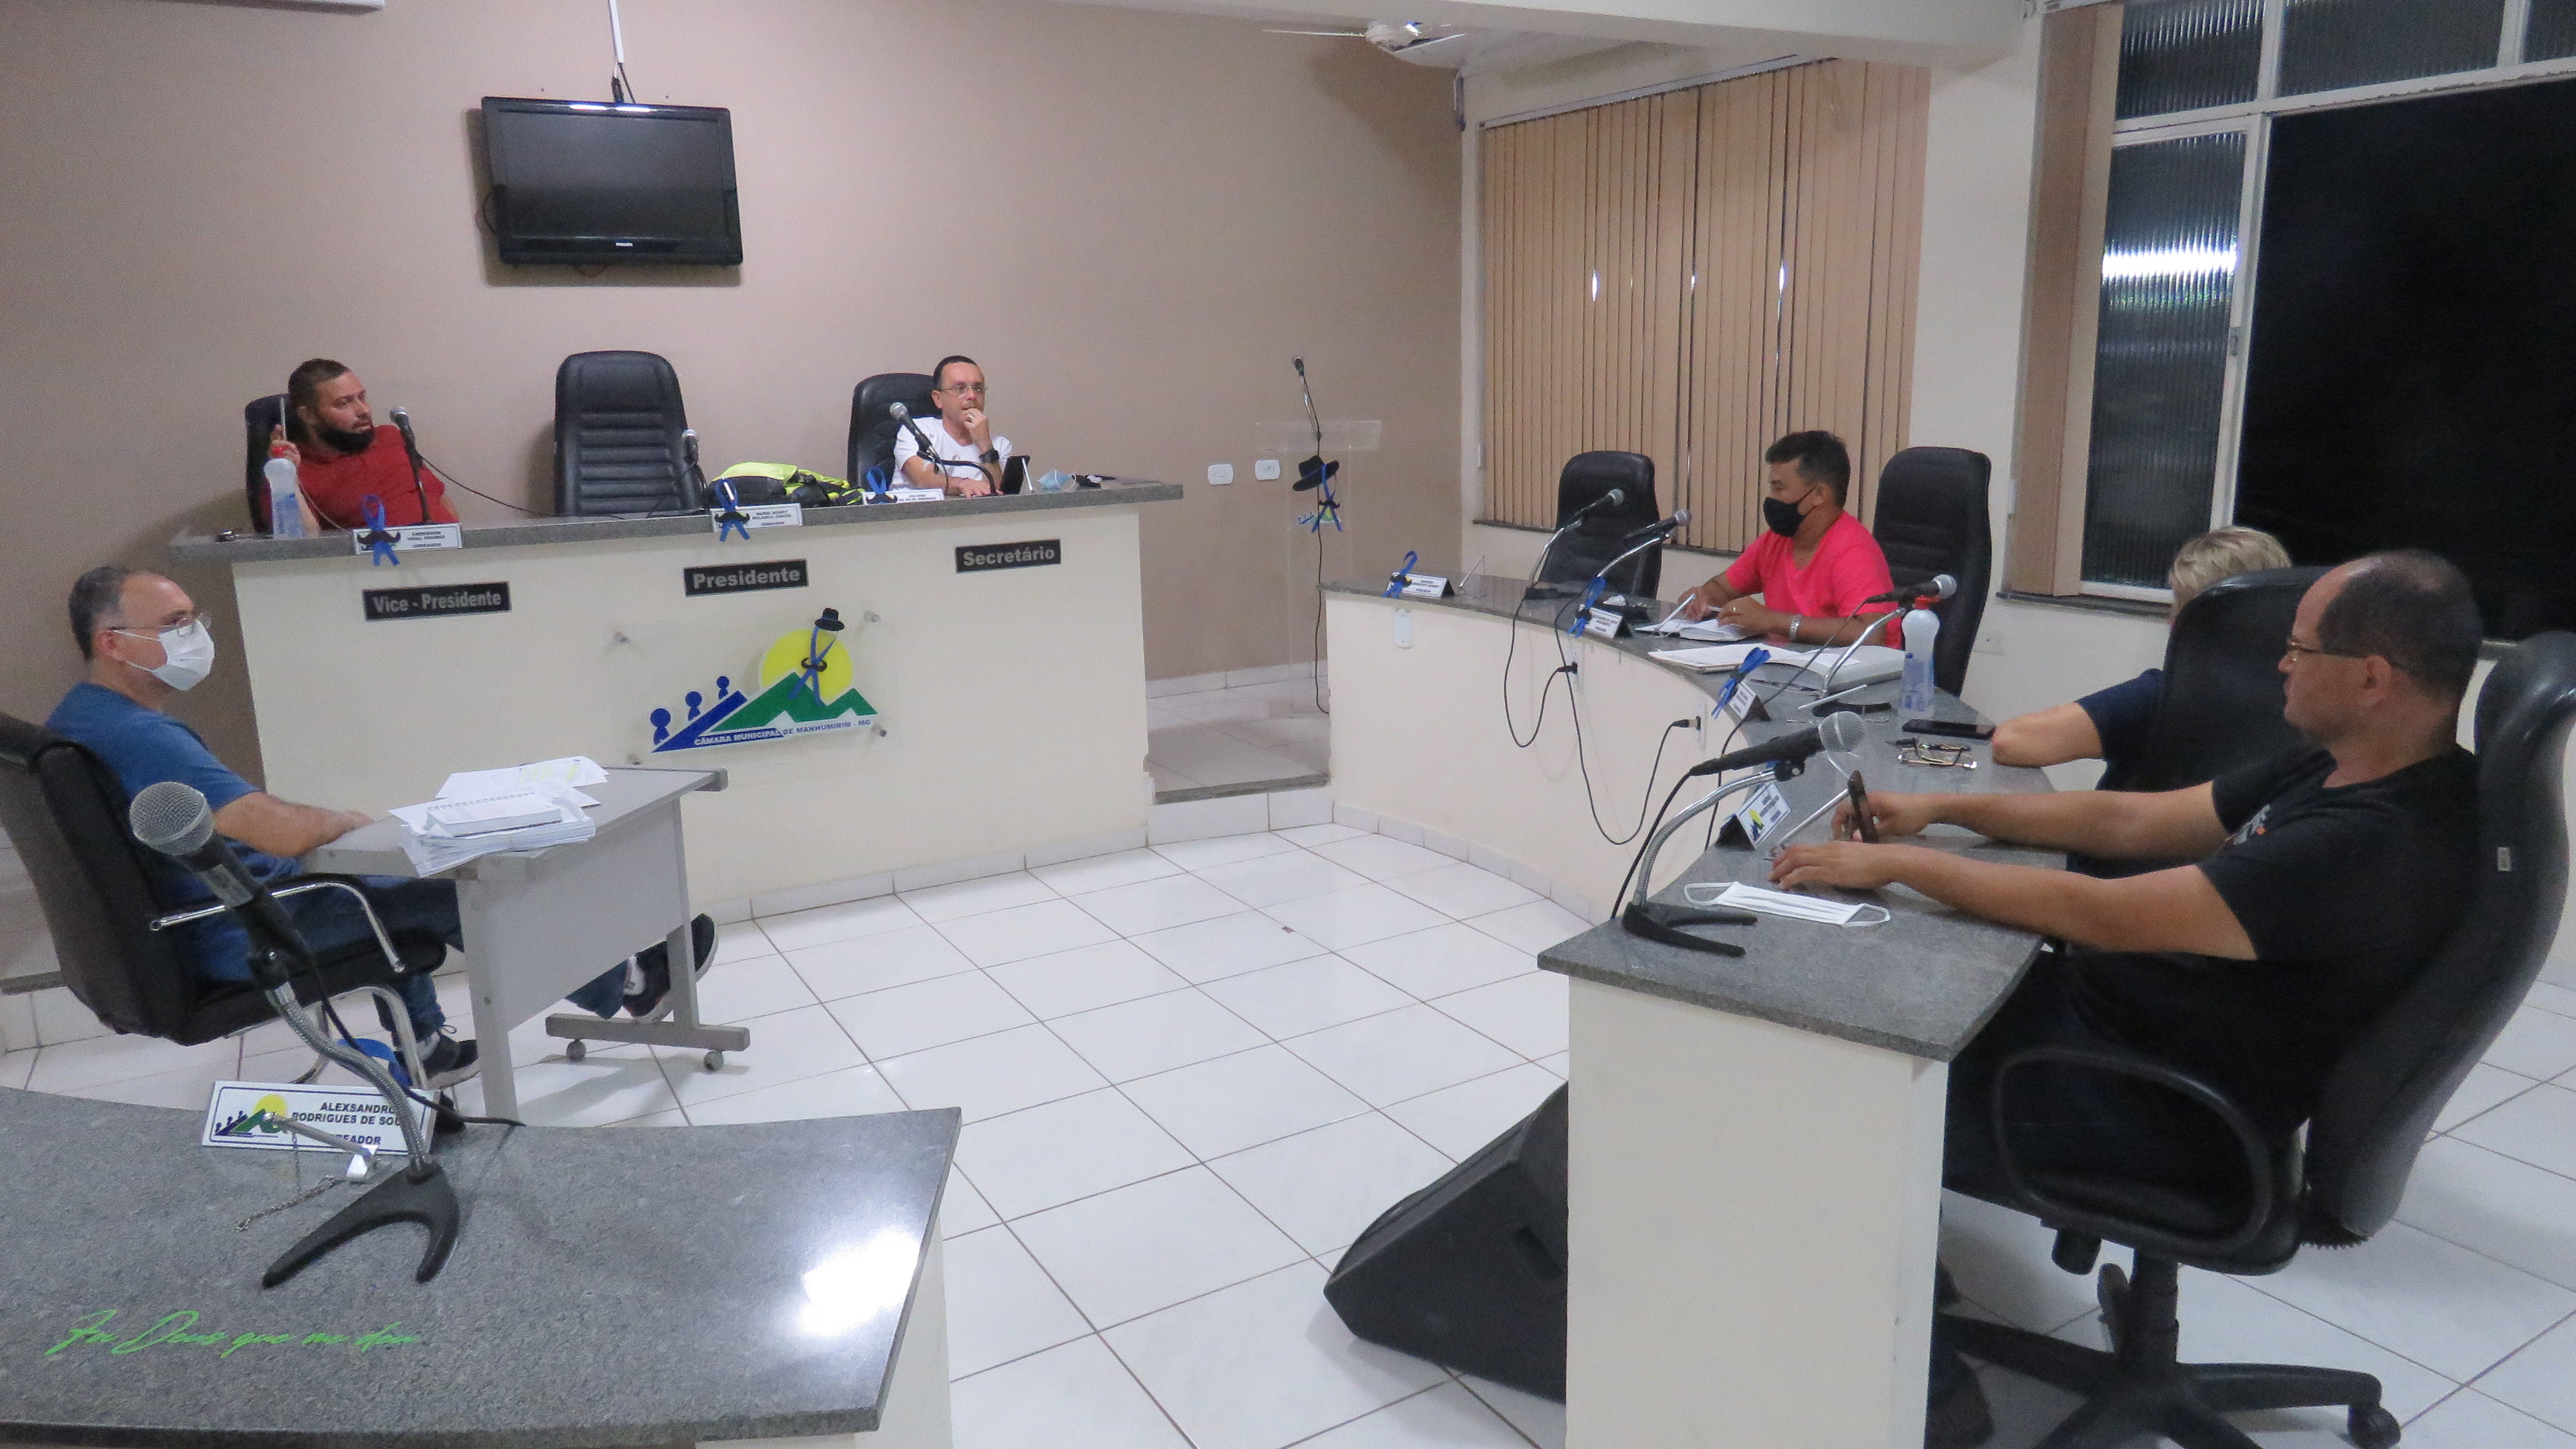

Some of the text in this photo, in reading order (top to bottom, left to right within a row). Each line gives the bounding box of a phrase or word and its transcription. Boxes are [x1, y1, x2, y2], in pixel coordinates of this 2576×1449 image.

[963, 546, 1055, 566] Secretário
[693, 567, 801, 589] Presidente
[372, 595, 409, 613] Vice
[420, 590, 502, 610] Presidente
[694, 733, 732, 746] CÂMARA
[733, 728, 781, 741] MUNICIPAL
[796, 721, 851, 735] MANHUMIRIM
[292, 1112, 357, 1124] RODRIGUES
[360, 1115, 376, 1125] DE
